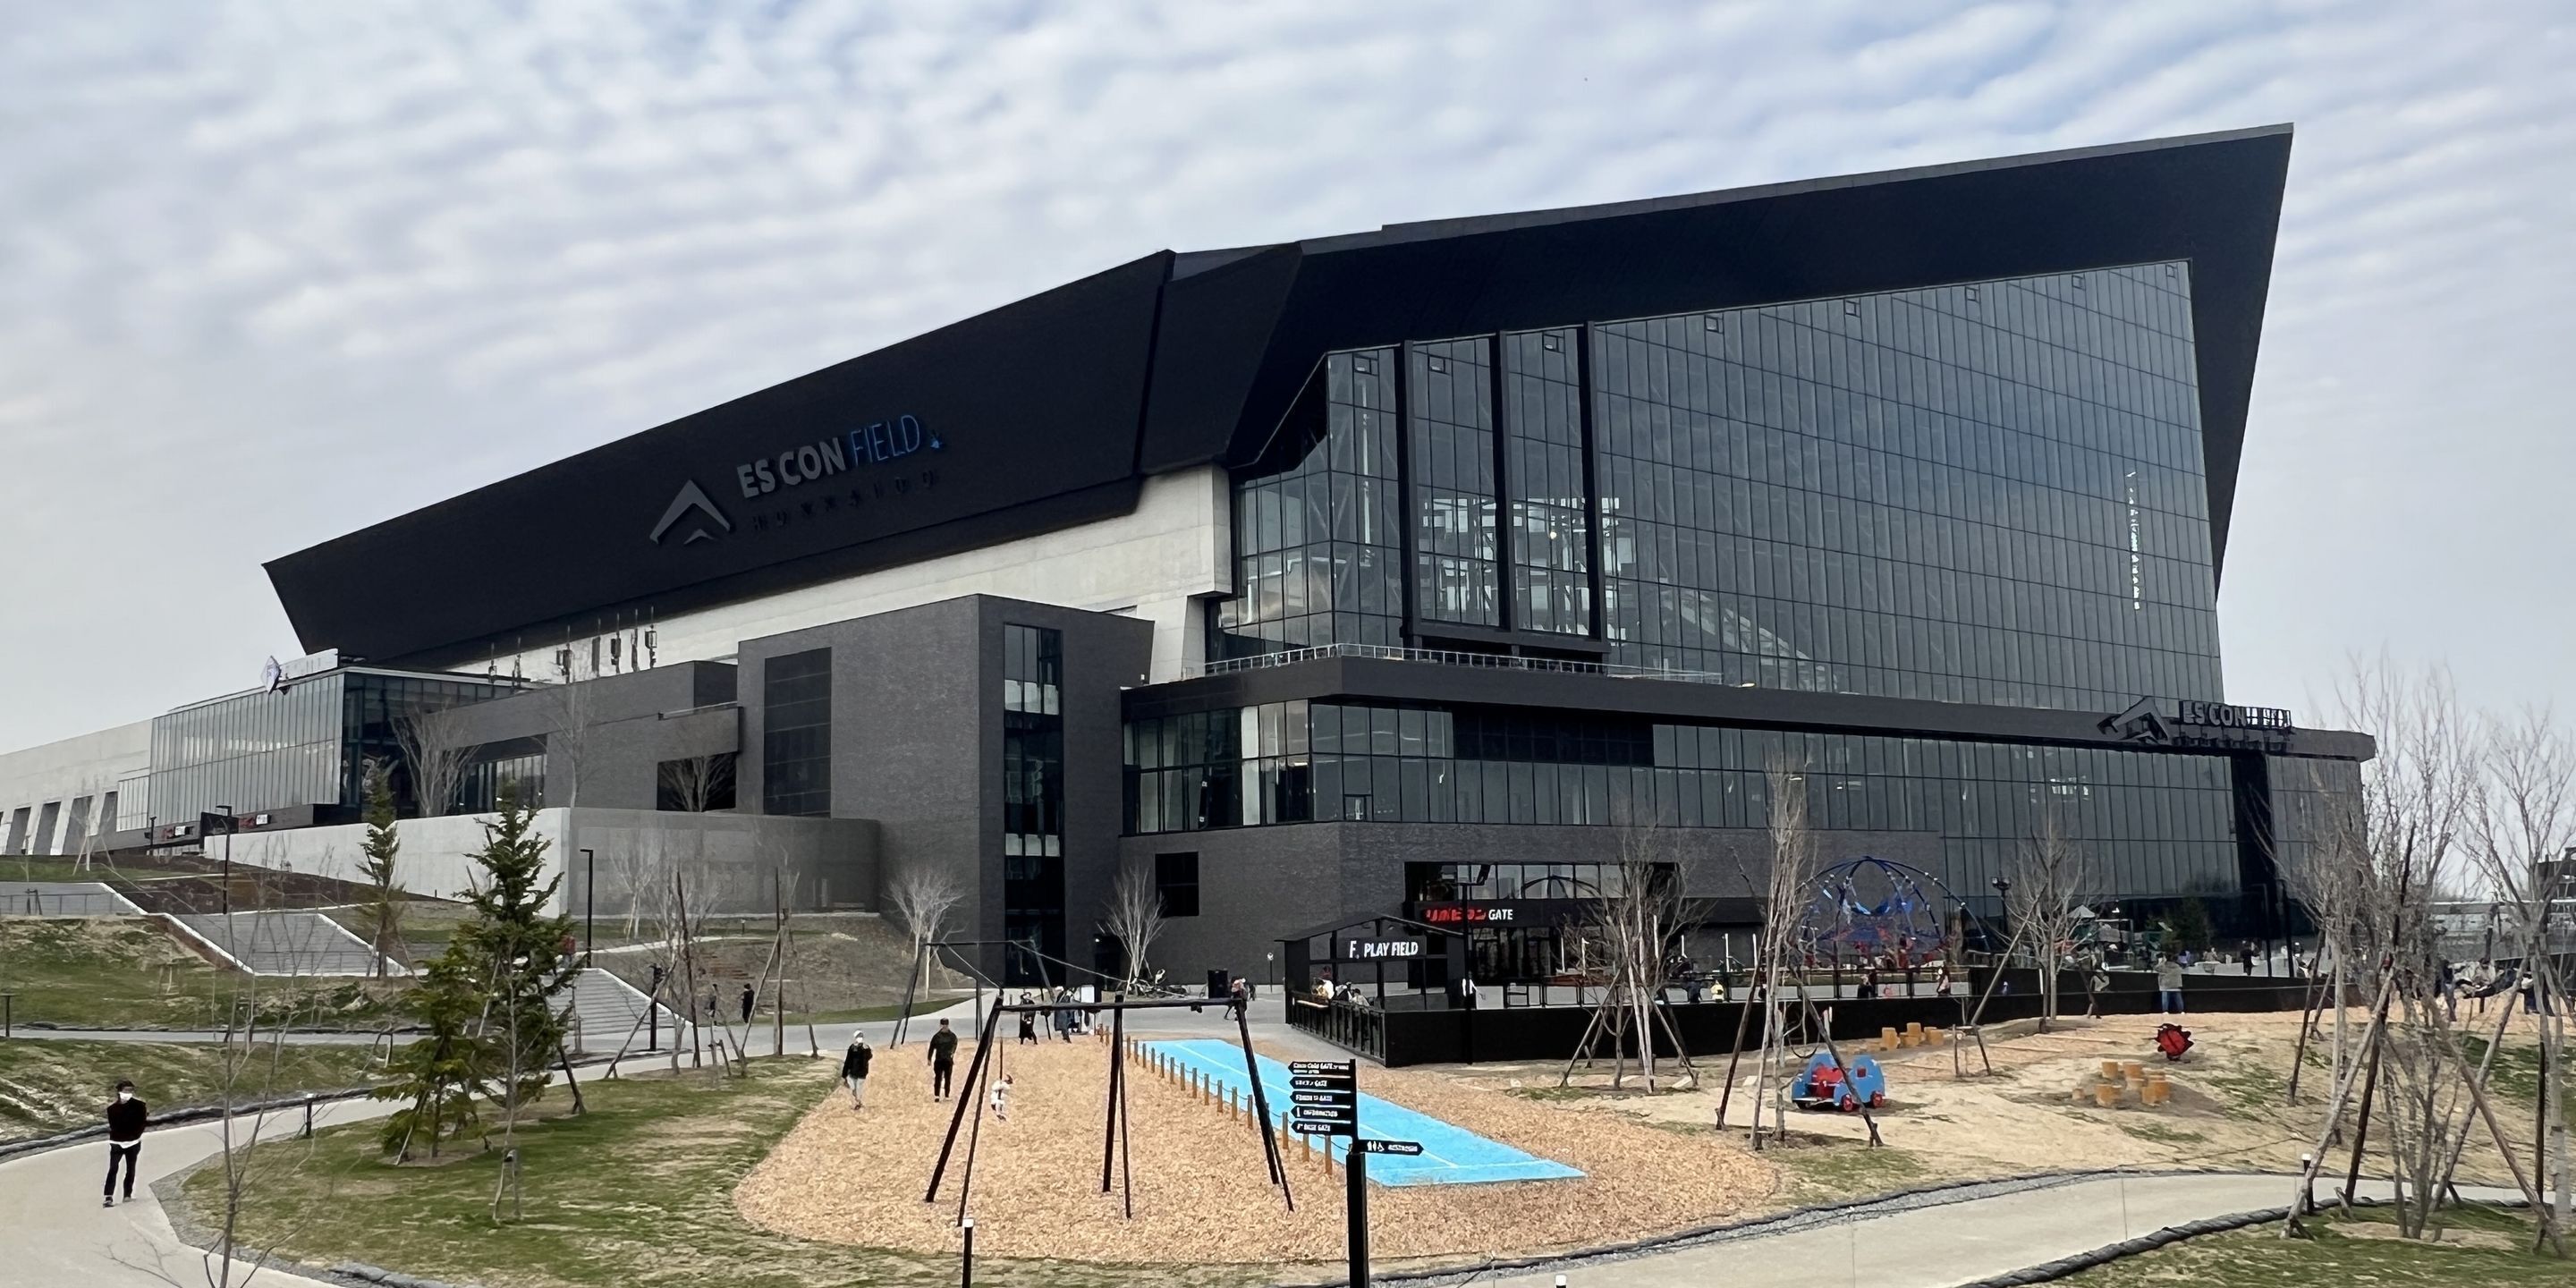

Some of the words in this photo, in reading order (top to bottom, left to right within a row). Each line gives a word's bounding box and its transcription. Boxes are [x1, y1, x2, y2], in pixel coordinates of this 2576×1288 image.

[851, 414, 920, 467] FIELD
[1488, 909, 1513, 920] GATE
[1364, 942, 1390, 958] PLAY
[1391, 942, 1419, 956] FIELD
